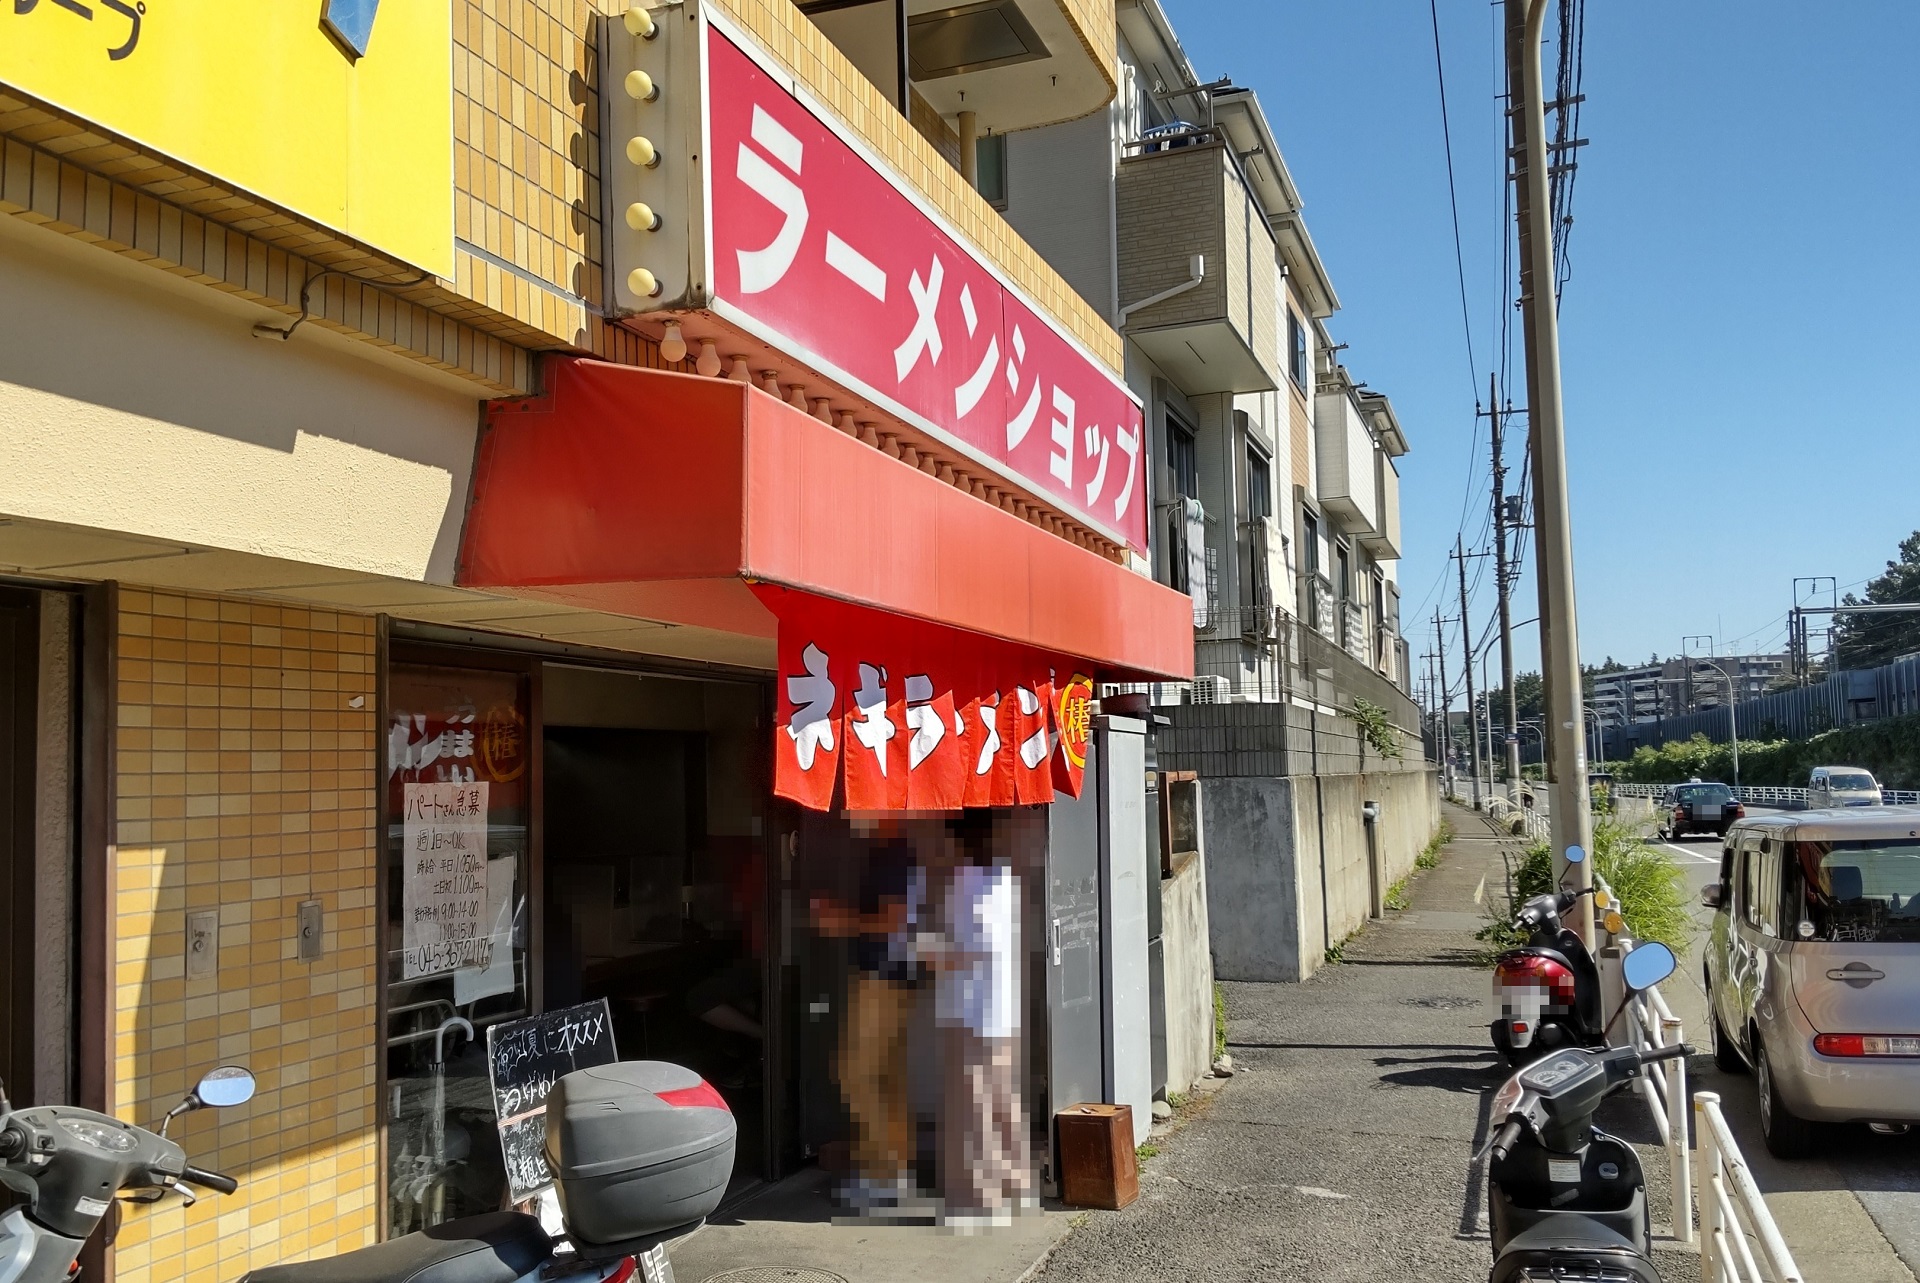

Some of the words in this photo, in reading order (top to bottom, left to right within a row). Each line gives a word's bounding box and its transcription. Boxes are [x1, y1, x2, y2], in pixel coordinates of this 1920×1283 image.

[735, 102, 1140, 522] ラーメンショップ
[407, 790, 481, 821] パートさん急募
